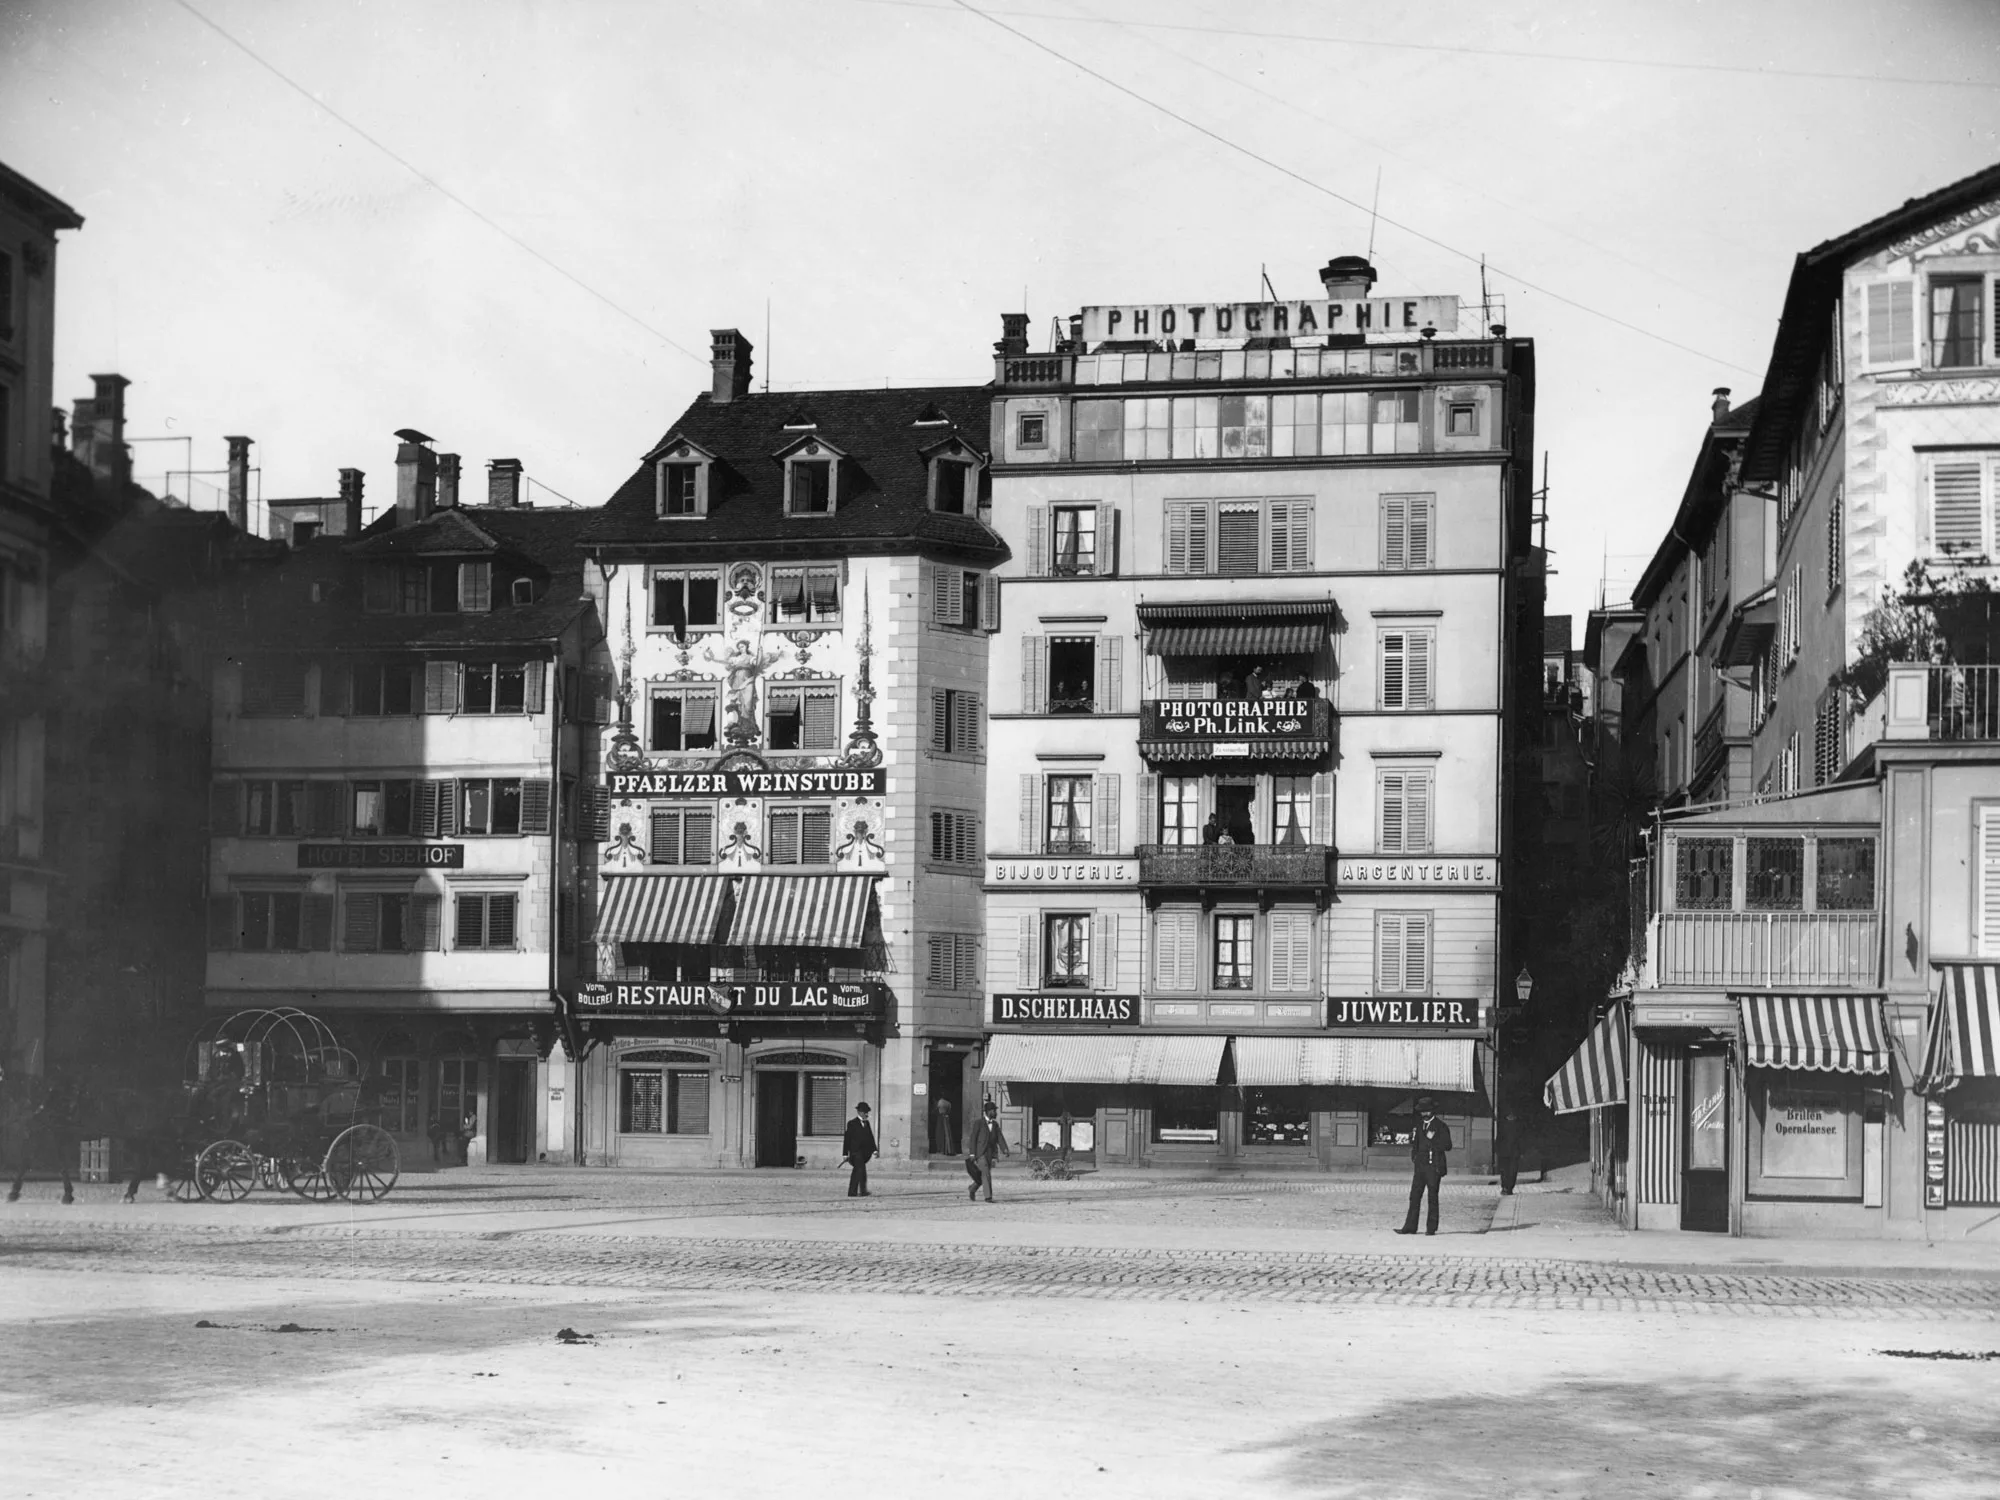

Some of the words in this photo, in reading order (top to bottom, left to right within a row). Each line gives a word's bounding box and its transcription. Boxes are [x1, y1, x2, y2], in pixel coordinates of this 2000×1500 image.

[1107, 301, 1435, 335] PHOTOGRAPHIE.
[1159, 701, 1308, 717] PHOTOGRAPHIE
[613, 773, 727, 793] PFAELZER
[737, 772, 875, 792] WEINSTUBE
[308, 847, 368, 864] HOTEL
[378, 847, 456, 864] SEEHOF
[996, 865, 1132, 880] BIJOUTERIE.
[1343, 865, 1491, 880] ARGENTERIE.
[578, 992, 613, 1006] BOLLEREI
[617, 986, 746, 1006] RESTAURT
[754, 986, 780, 1006] DU
[790, 986, 828, 1006] LAC
[832, 994, 869, 1007] BOLLEREI
[1336, 1001, 1472, 1023] JUWELIER.
[1785, 1106, 1823, 1121] Brillen
